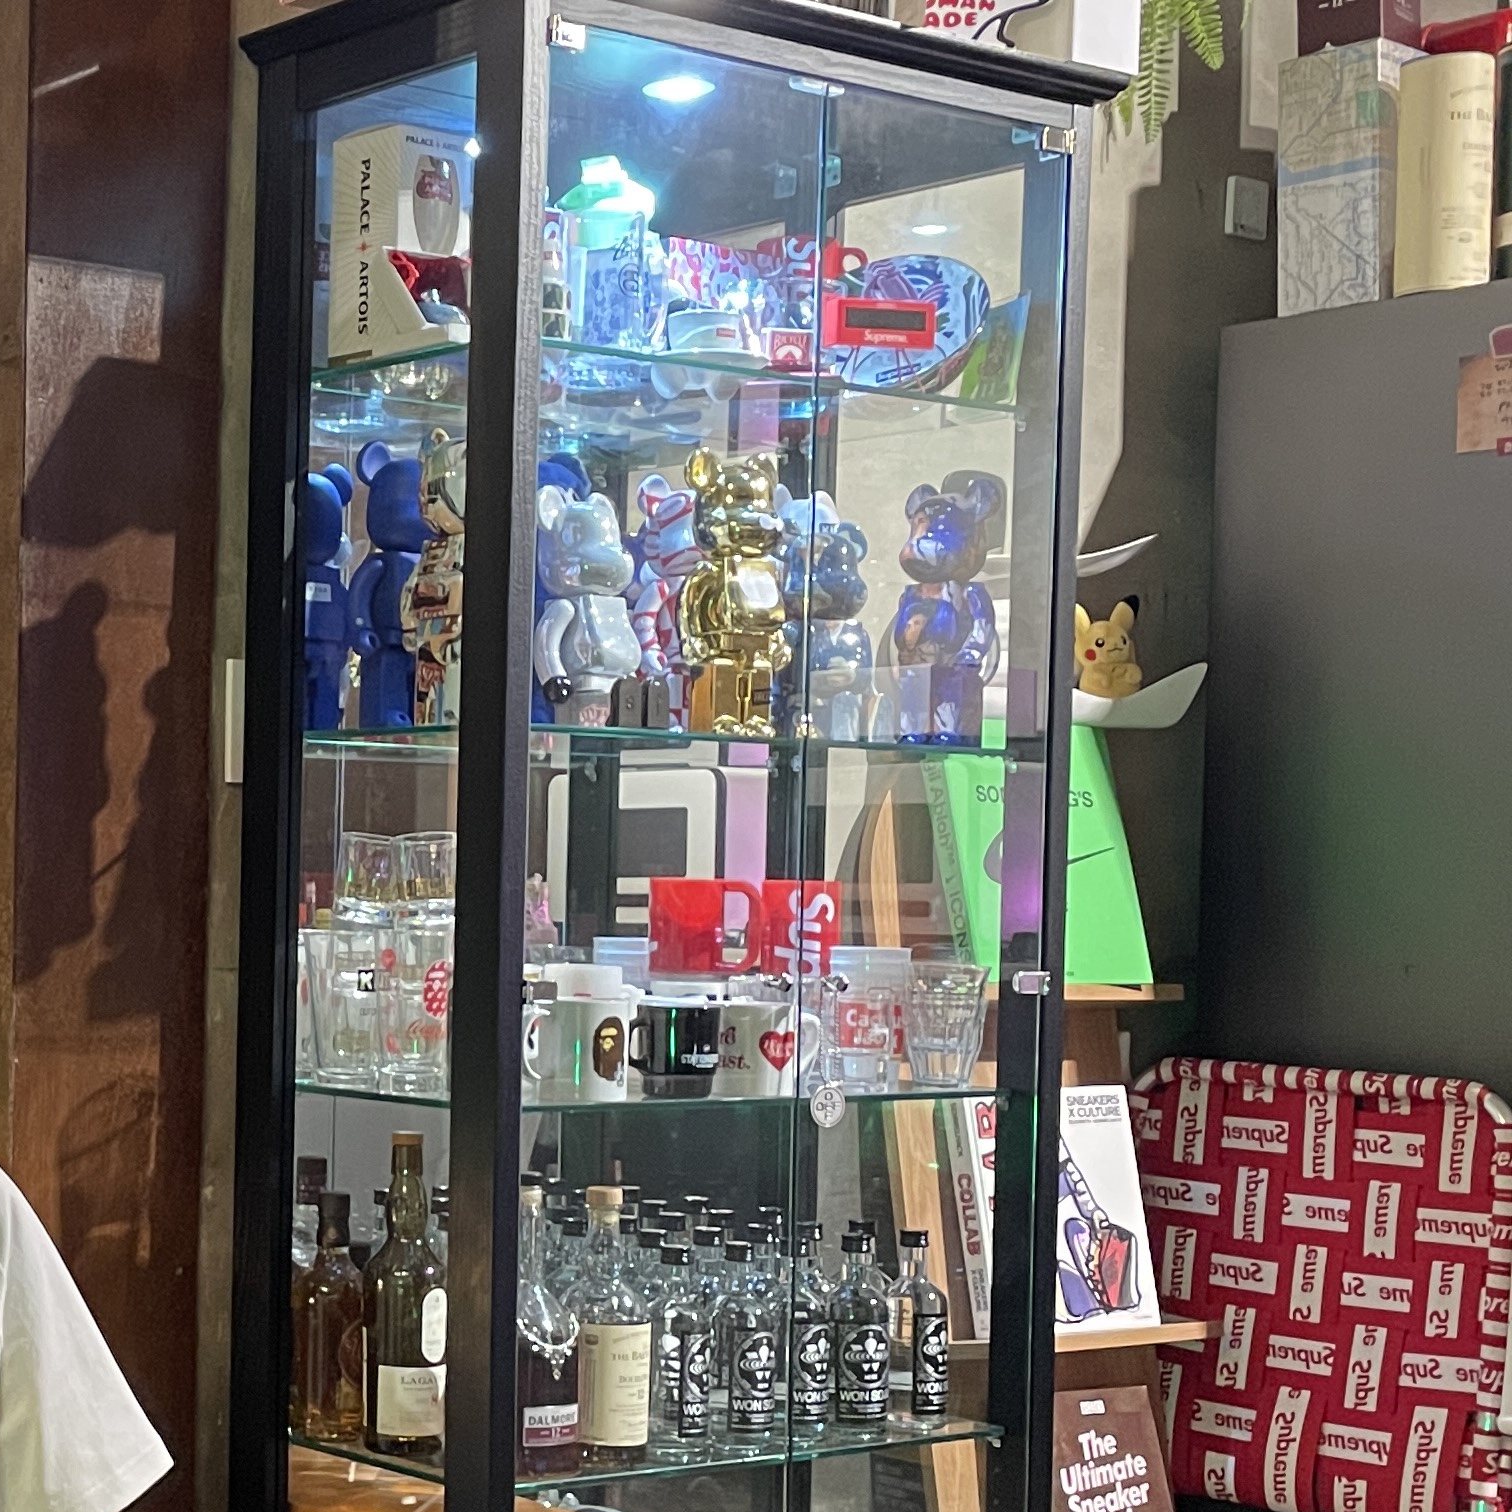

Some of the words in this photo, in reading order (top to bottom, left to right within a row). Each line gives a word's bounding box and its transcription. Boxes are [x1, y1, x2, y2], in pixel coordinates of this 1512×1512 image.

[922, 12, 978, 27] ADE
[359, 157, 372, 236] PALACE
[357, 260, 370, 335] ARTOIS
[863, 330, 909, 344] Supreme
[1066, 1094, 1120, 1107] SNEAKERS
[1068, 1107, 1076, 1118] X
[1077, 1106, 1122, 1118] CULTURE
[956, 1173, 982, 1257] COLLAB
[839, 1390, 870, 1402] WON
[731, 1399, 762, 1411] WON
[528, 1411, 576, 1427] DALMORE
[1077, 1429, 1118, 1461] The
[1059, 1453, 1148, 1495] Ultimate
